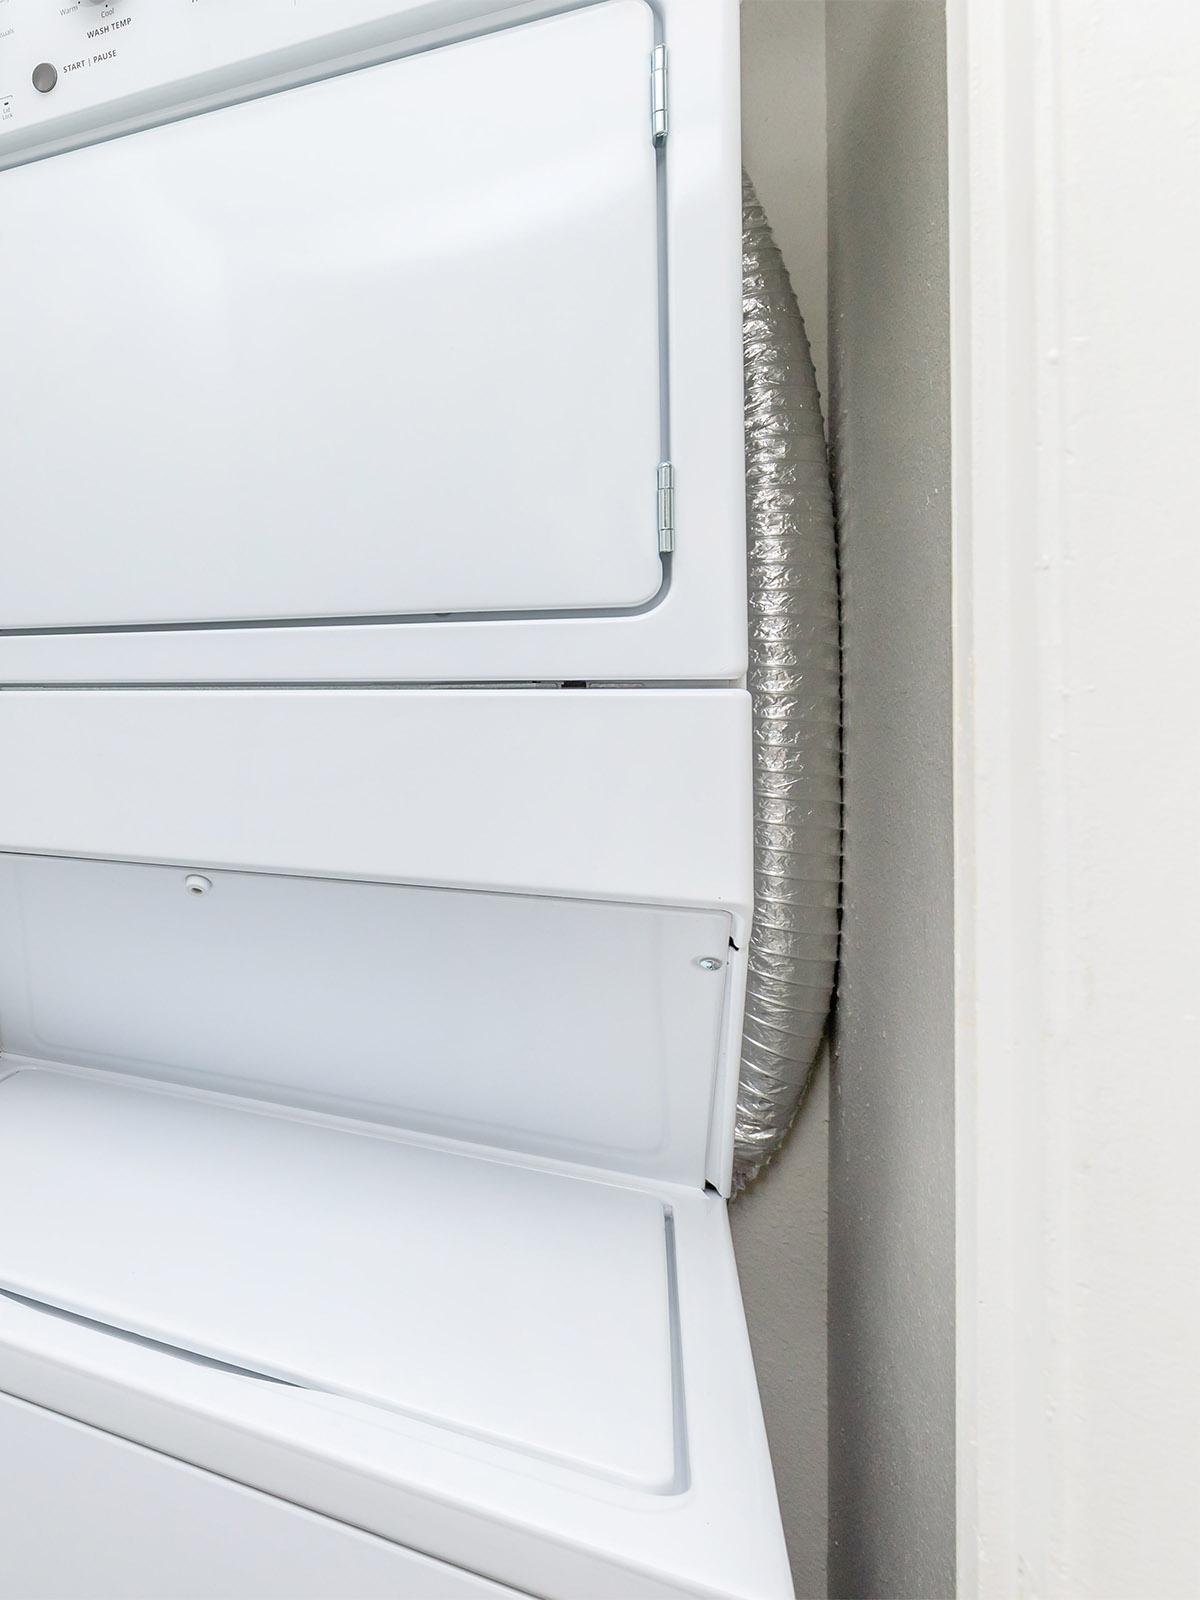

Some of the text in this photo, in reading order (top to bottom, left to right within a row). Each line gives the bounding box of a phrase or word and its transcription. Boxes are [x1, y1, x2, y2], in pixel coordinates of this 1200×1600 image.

[60, 5, 79, 16] Warm
[101, 8, 115, 18] Cool
[86, 17, 132, 39] WASH TEMP
[63, 60, 85, 73] START
[93, 49, 117, 64] PAUSE
